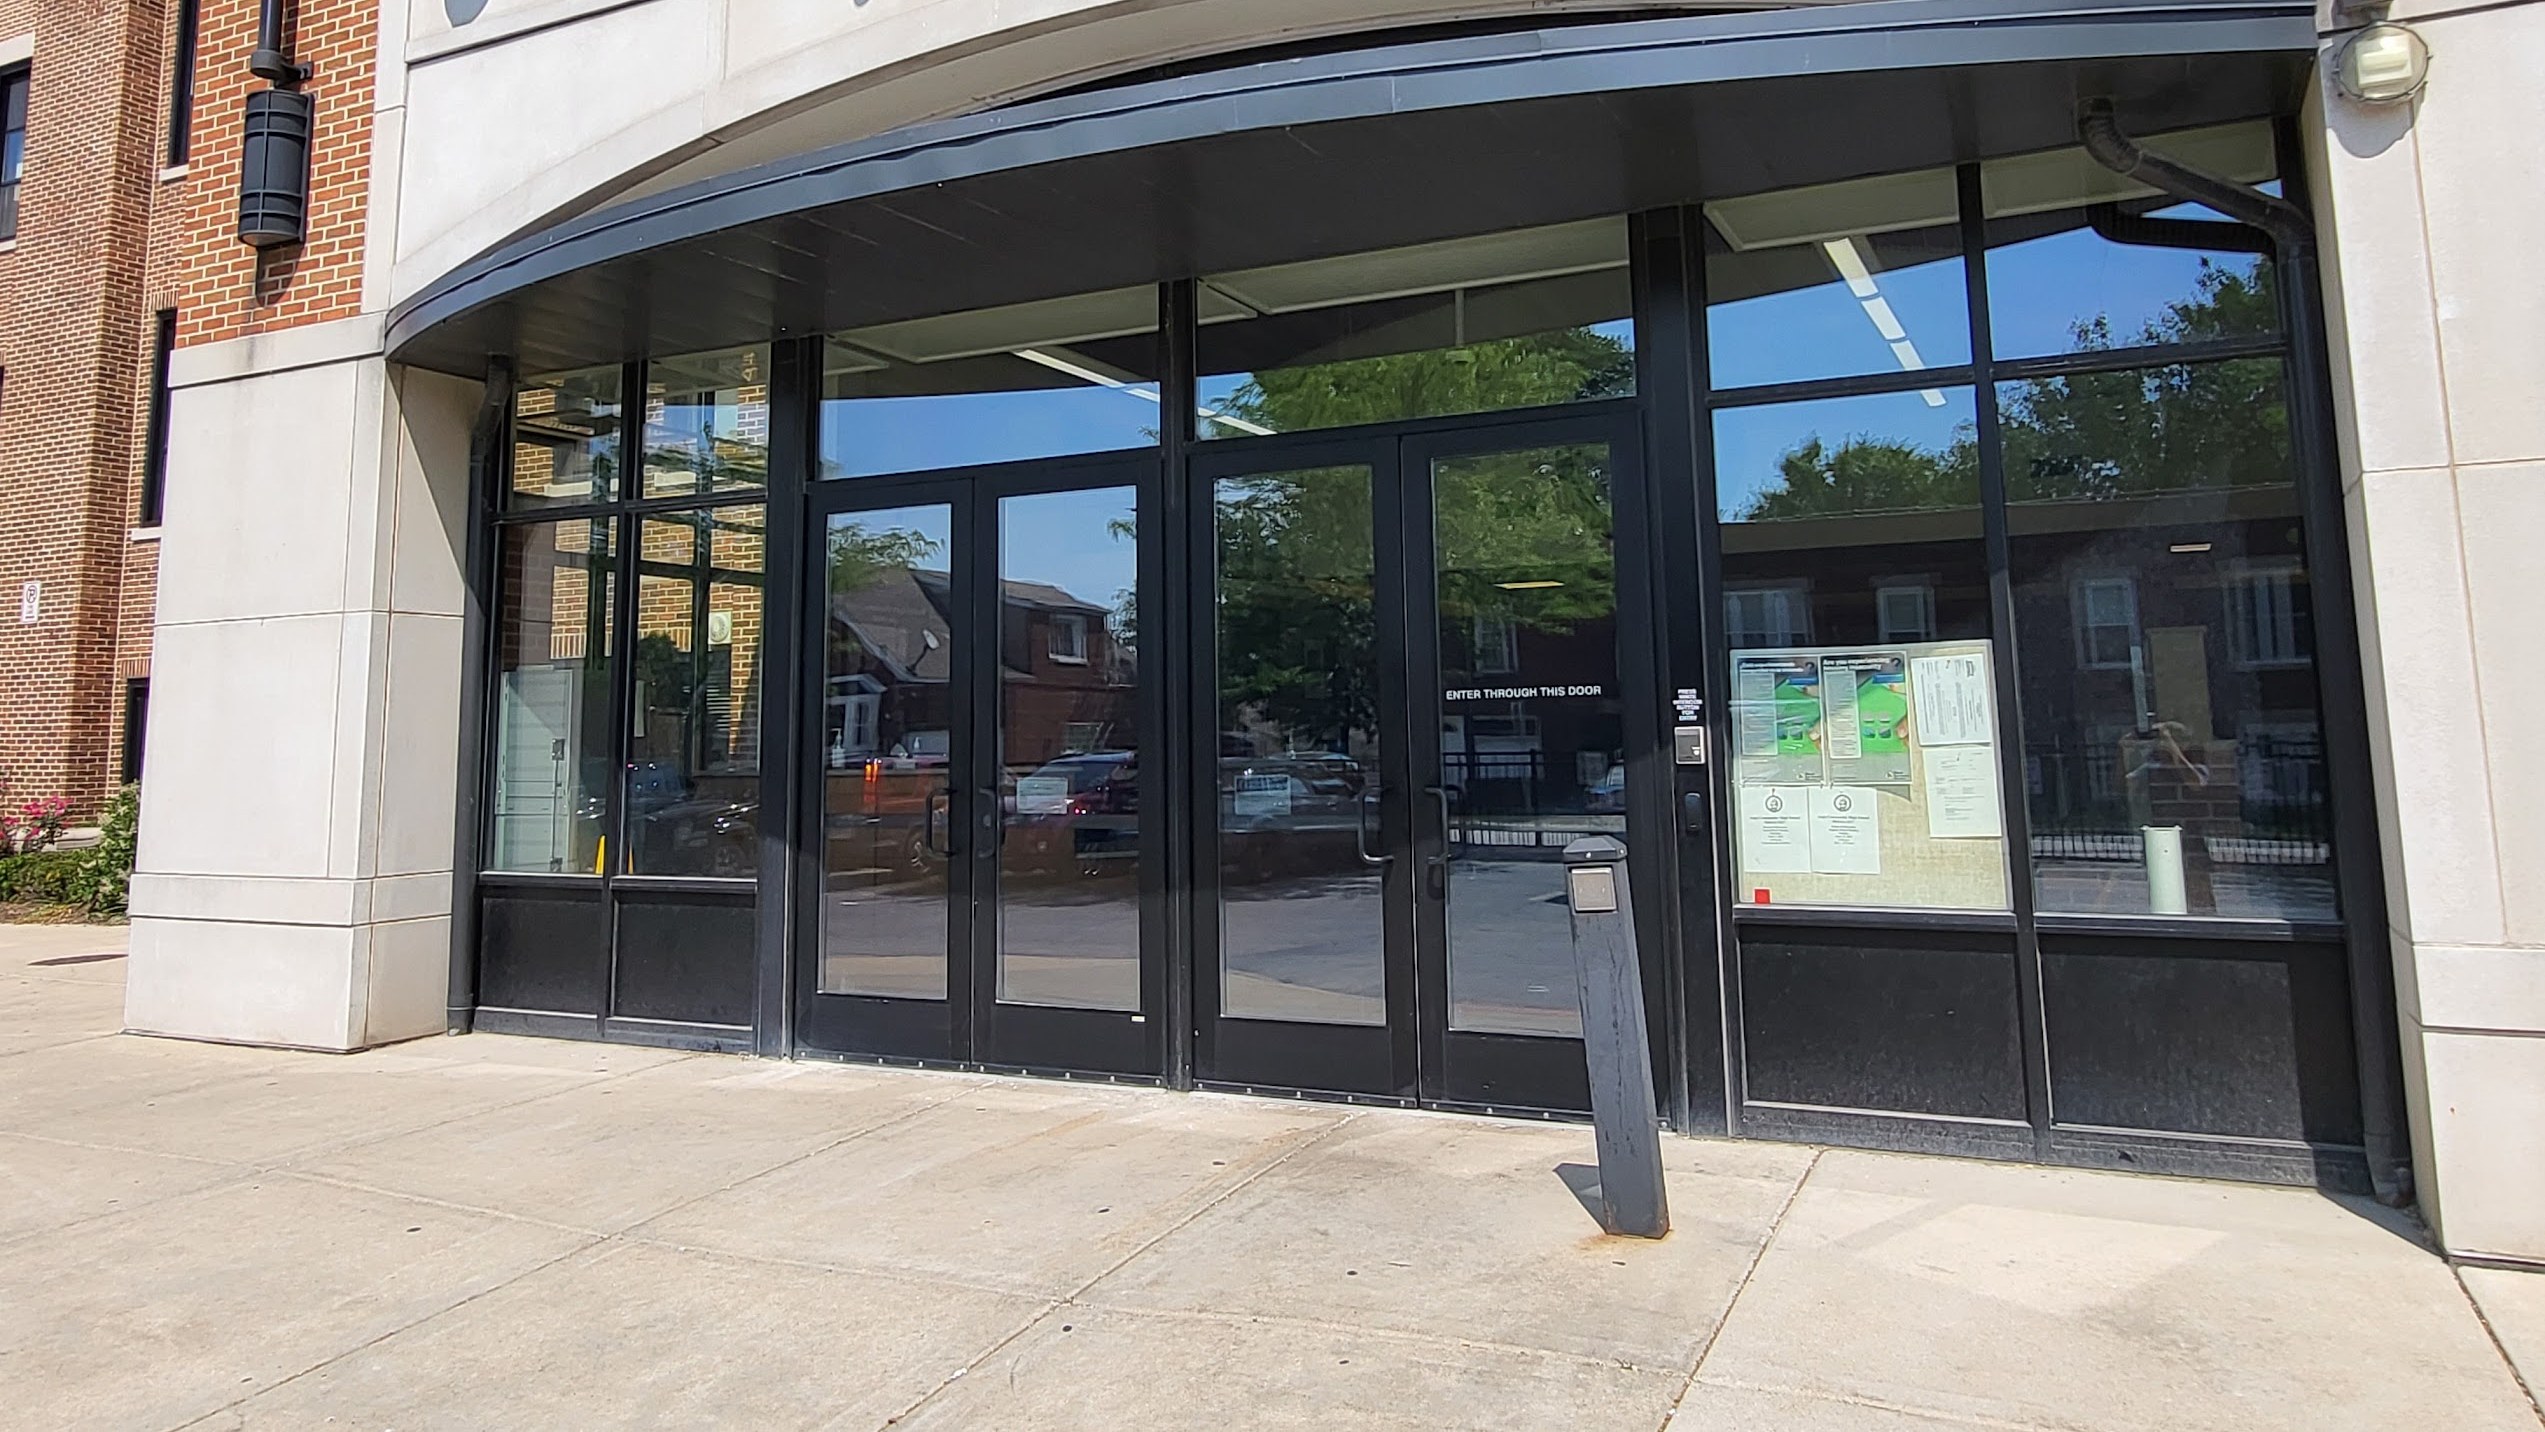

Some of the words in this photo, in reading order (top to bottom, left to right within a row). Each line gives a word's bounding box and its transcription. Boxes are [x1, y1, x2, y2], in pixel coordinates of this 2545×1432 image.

[1446, 689, 1481, 700] ENTER
[1483, 687, 1538, 699] THROUGH
[1540, 686, 1566, 697] THIS
[1568, 685, 1602, 696] DOOR
